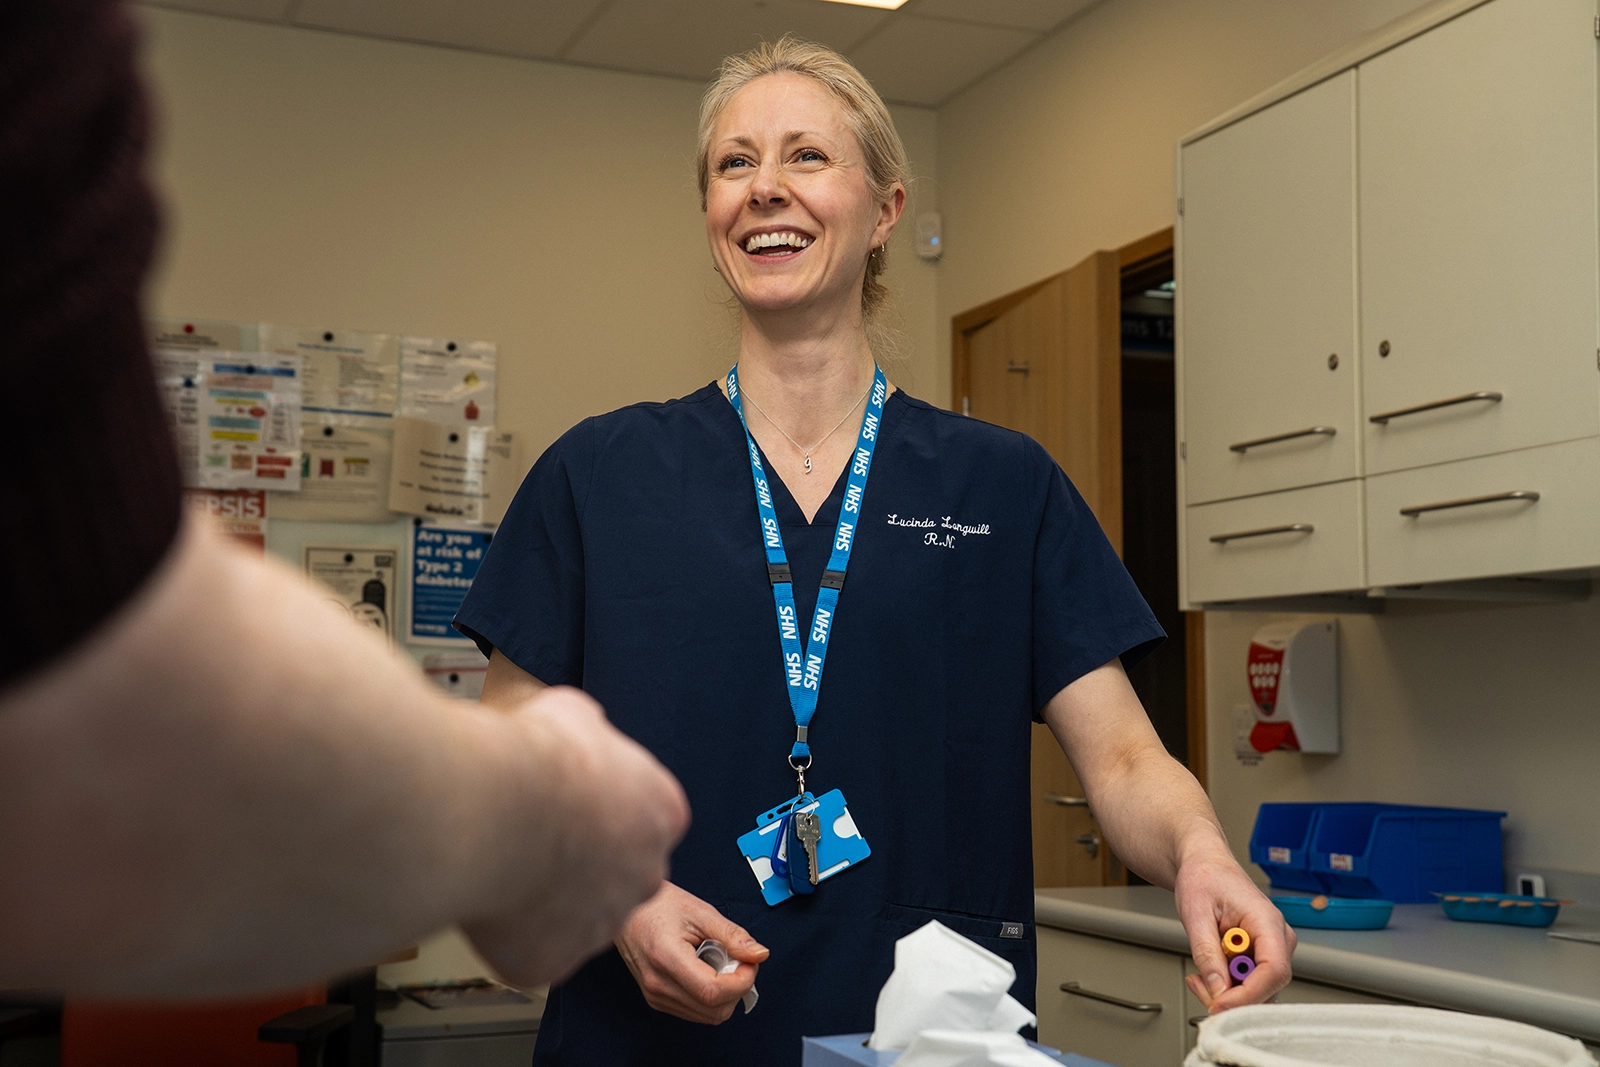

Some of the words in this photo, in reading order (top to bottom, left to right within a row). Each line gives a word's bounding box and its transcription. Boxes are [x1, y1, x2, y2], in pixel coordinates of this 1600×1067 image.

[871, 379, 885, 409] NHS
[862, 412, 879, 442] NHS
[853, 448, 871, 477] NHS
[756, 477, 772, 508] NHS
[845, 484, 862, 514] NHS
[417, 530, 443, 543] Are
[445, 533, 472, 545] you
[763, 517, 780, 548] NHS
[836, 522, 853, 552] NHS
[887, 513, 937, 528] Lucinda
[941, 515, 991, 537] Longwill
[416, 546, 432, 557] at
[434, 546, 463, 558] risk
[465, 548, 482, 559] of
[924, 532, 956, 549] R.N.
[416, 559, 450, 573] Type
[453, 562, 463, 573] 2
[779, 605, 797, 639] NHS
[812, 608, 831, 644] NHS
[786, 652, 802, 687] NHS
[803, 654, 822, 691] NHS
